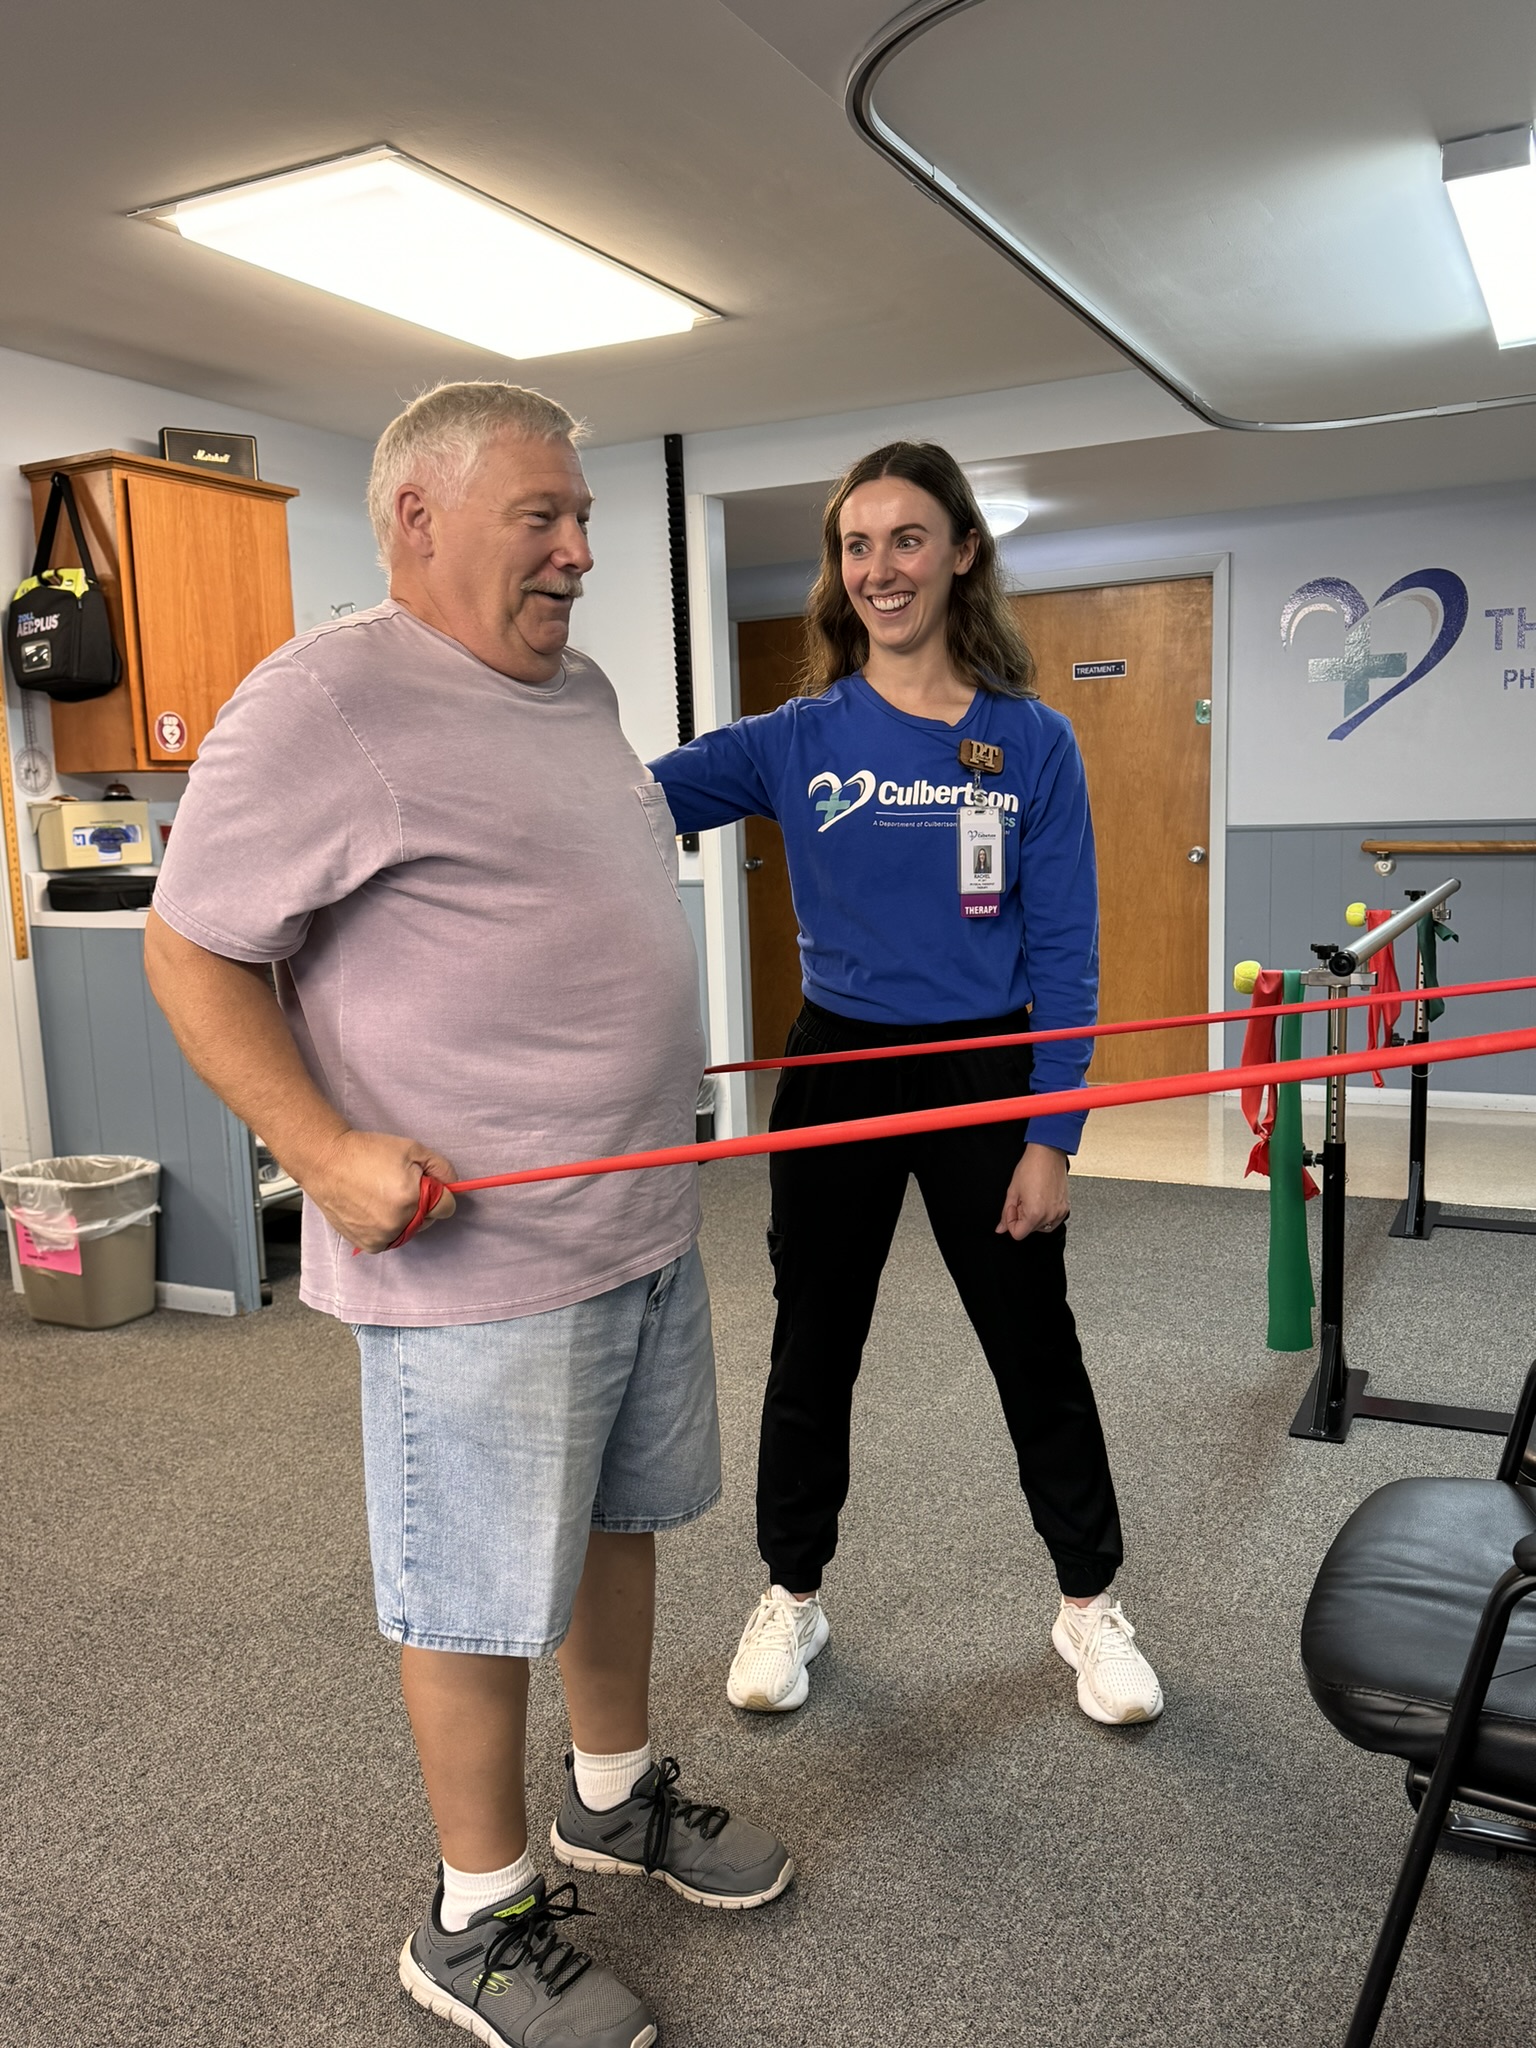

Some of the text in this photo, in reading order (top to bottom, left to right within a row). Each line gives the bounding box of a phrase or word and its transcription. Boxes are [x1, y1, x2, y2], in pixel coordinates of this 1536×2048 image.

[1076, 665, 1116, 675] TREATMENT
[1504, 668, 1535, 690] PH
[878, 780, 1019, 813] Culbertson
[879, 820, 916, 828] Department
[965, 905, 998, 915] THERAPY
